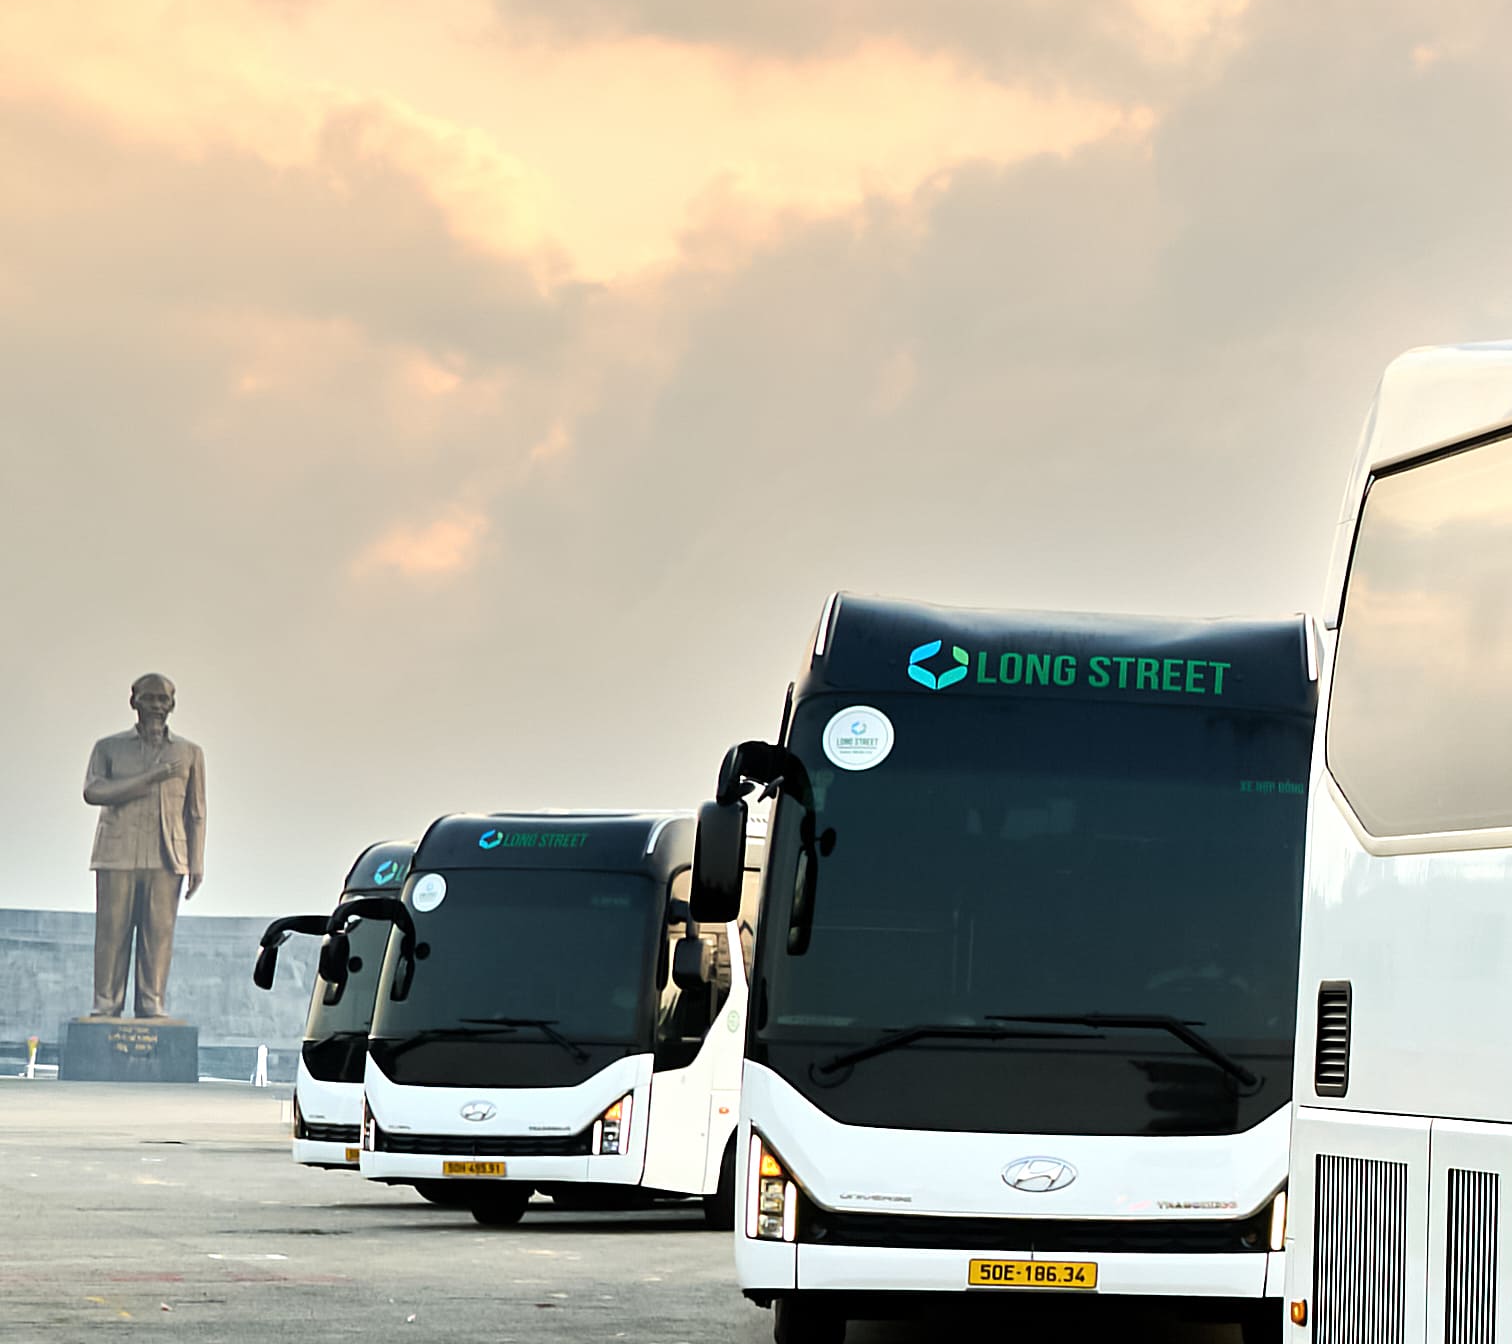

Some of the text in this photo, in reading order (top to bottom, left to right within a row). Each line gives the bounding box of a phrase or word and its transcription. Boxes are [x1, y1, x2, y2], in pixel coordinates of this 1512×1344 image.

[977, 651, 1231, 695] LONG STREET
[538, 832, 588, 848] STREET
[979, 1263, 1087, 1284] 50E-186.34
